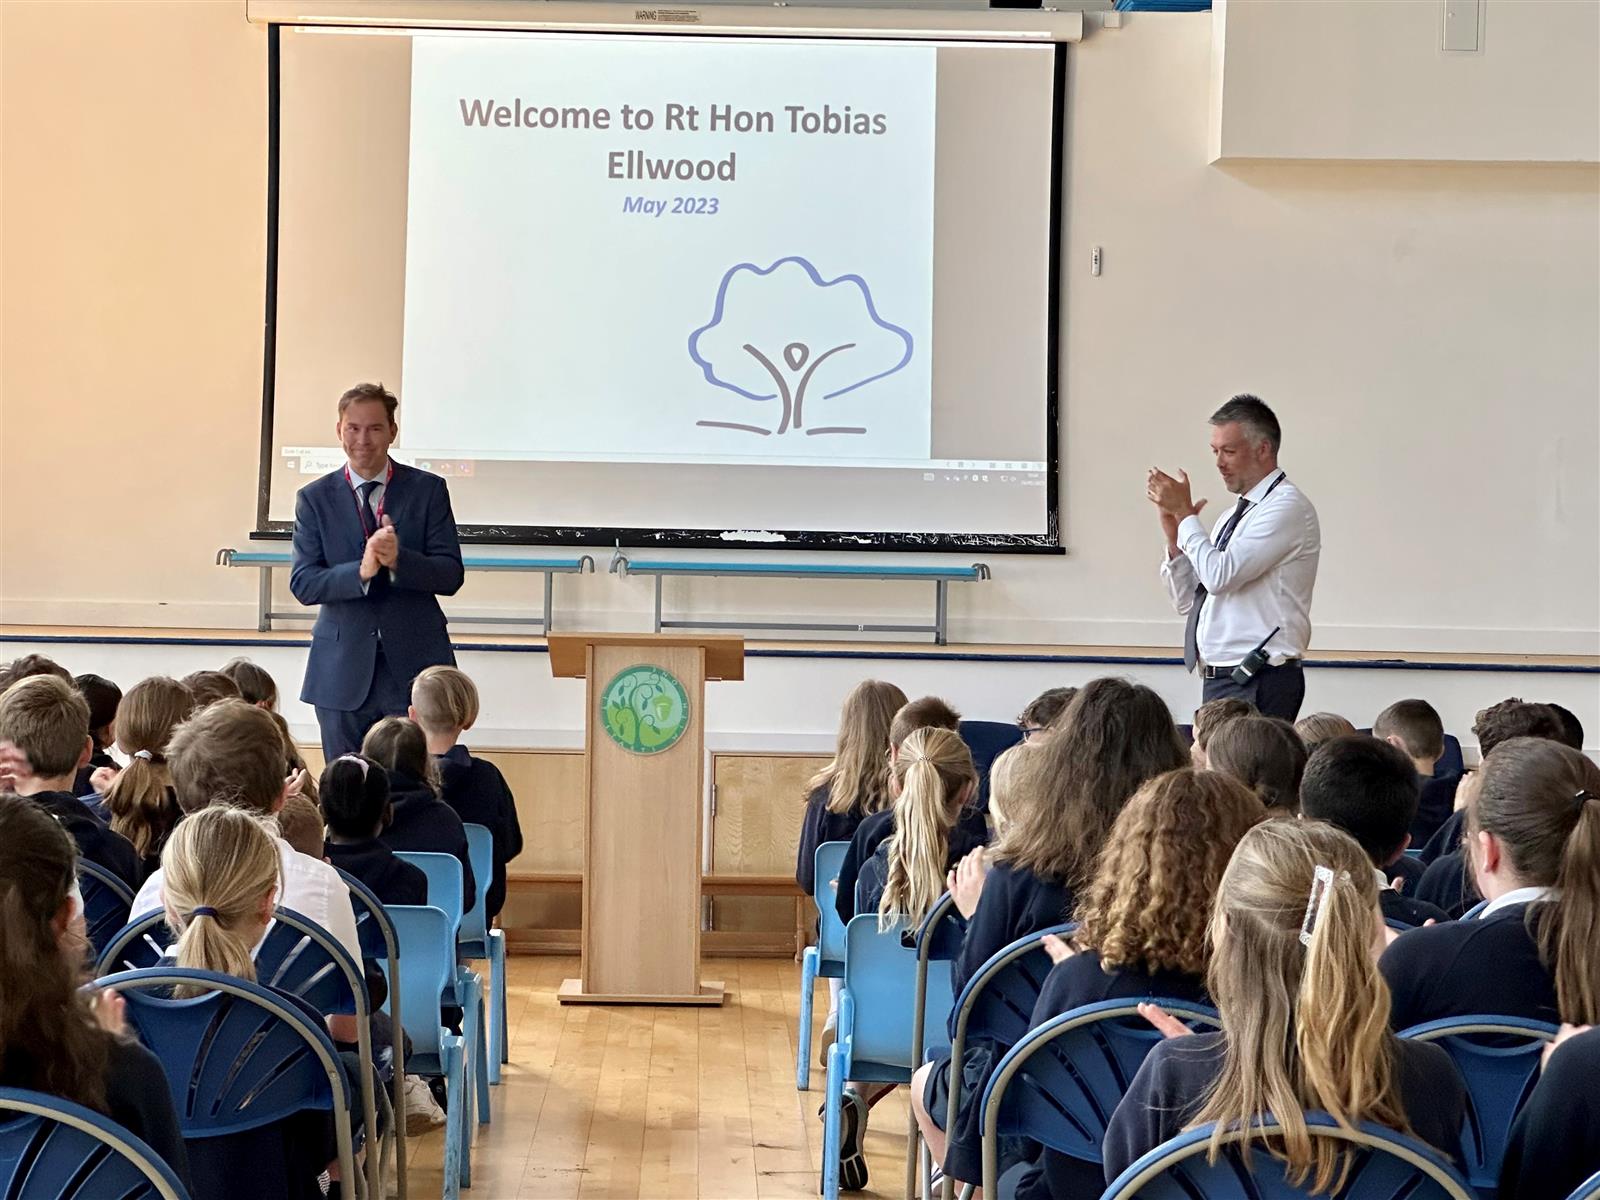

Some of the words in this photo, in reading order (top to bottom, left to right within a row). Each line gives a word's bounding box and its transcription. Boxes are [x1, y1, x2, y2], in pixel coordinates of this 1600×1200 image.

[635, 10, 657, 21] WARNING
[459, 98, 611, 130] Welcome
[620, 104, 654, 131] to
[665, 104, 700, 131] Rt
[710, 104, 774, 133] Hon
[784, 105, 887, 135] Tobias
[608, 150, 736, 181] Ellwood
[622, 197, 667, 217] May
[671, 197, 720, 214] 2023
